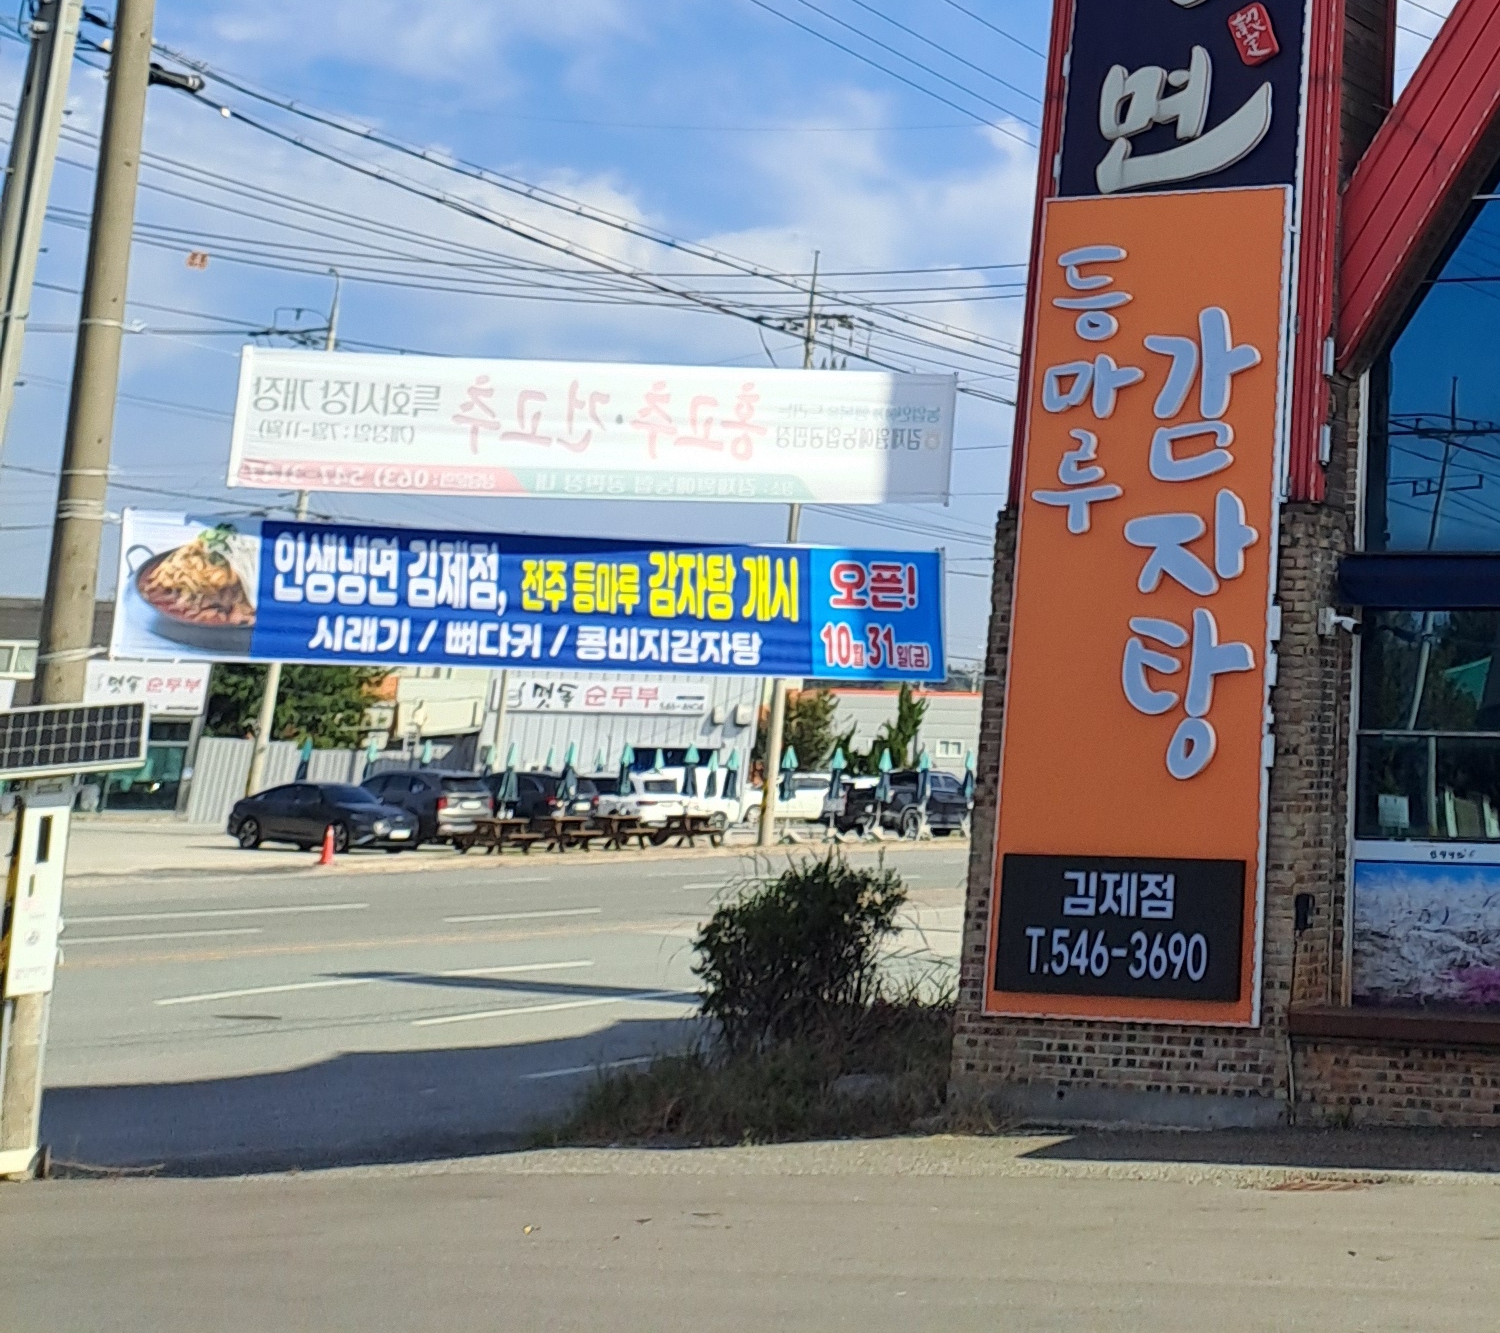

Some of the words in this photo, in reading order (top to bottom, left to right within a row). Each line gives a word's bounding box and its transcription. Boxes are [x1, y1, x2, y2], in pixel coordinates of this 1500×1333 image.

[1032, 244, 1144, 534] 등마루
[1122, 307, 1262, 780] 감자탕
[273, 531, 399, 607] 인생냉면
[408, 538, 507, 616] 김제점,
[521, 559, 568, 613] 전주
[572, 561, 641, 616] 등마루
[648, 551, 737, 620] 감자탕
[741, 556, 799, 623] 개시
[830, 560, 919, 610] 오픈!
[308, 615, 410, 654] 시래기
[445, 619, 542, 659] 뼈다귀
[575, 624, 762, 666] 콩비지감자탕
[820, 622, 866, 669] 10월
[585, 685, 659, 709] 순두부
[1062, 870, 1176, 921] 김제점
[1025, 927, 1208, 982] T.546-3690
